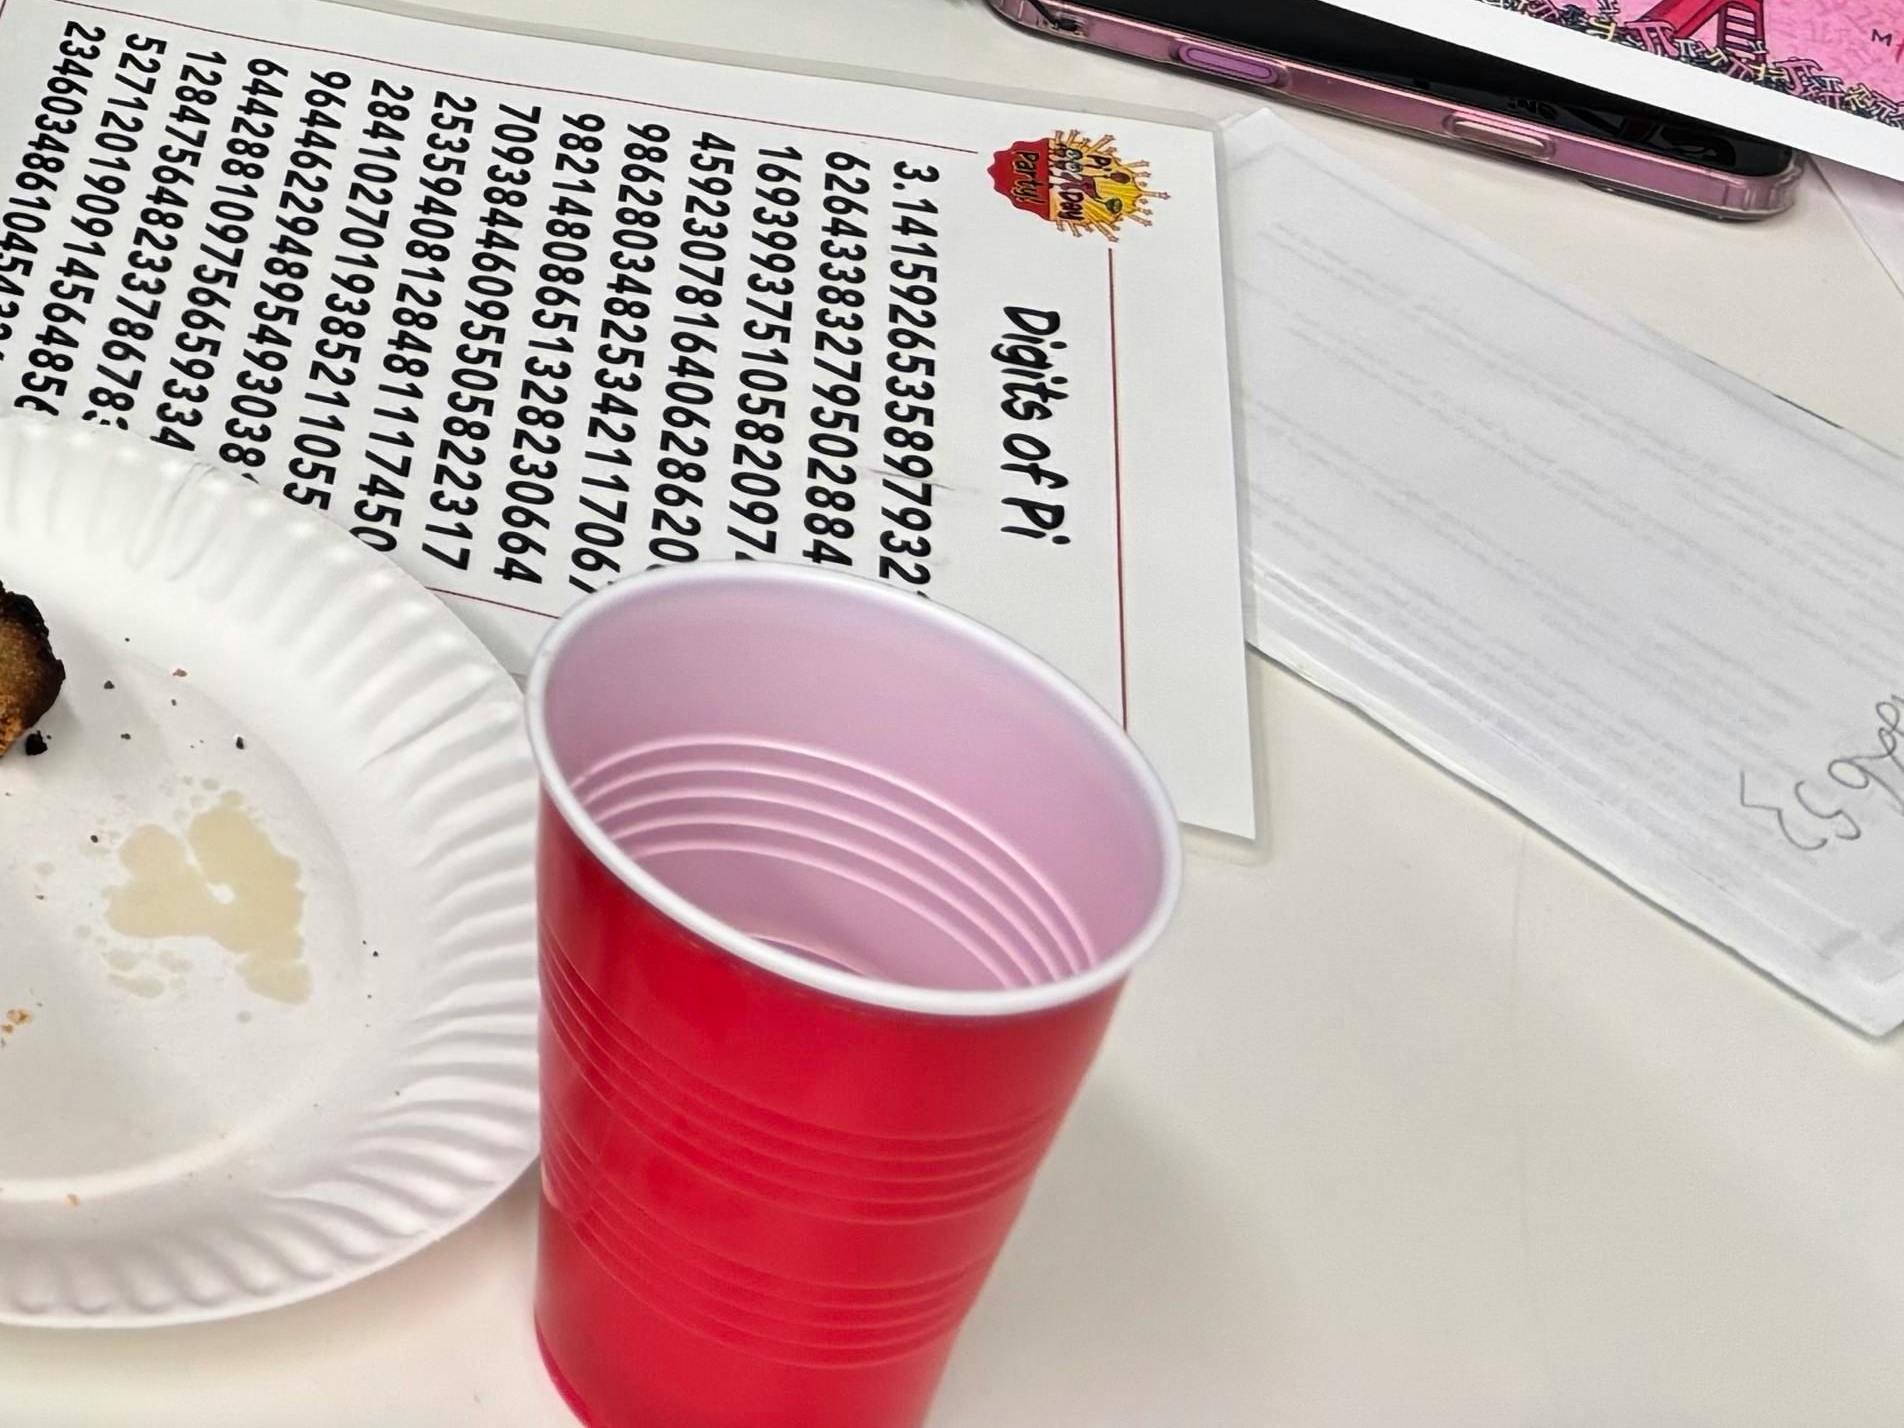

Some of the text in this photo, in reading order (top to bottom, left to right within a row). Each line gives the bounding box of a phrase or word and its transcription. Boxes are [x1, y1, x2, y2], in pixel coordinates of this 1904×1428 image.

[220, 72, 351, 481] 964462294895493038
[422, 104, 541, 570] 70938446095505822317
[494, 114, 605, 583] 98214808651328230664
[649, 132, 735, 562] 459230781640628620
[728, 147, 802, 560] 16939937510582097
[880, 162, 939, 584] 3.1415926535897932
[989, 304, 1074, 548] Digits of Pi
